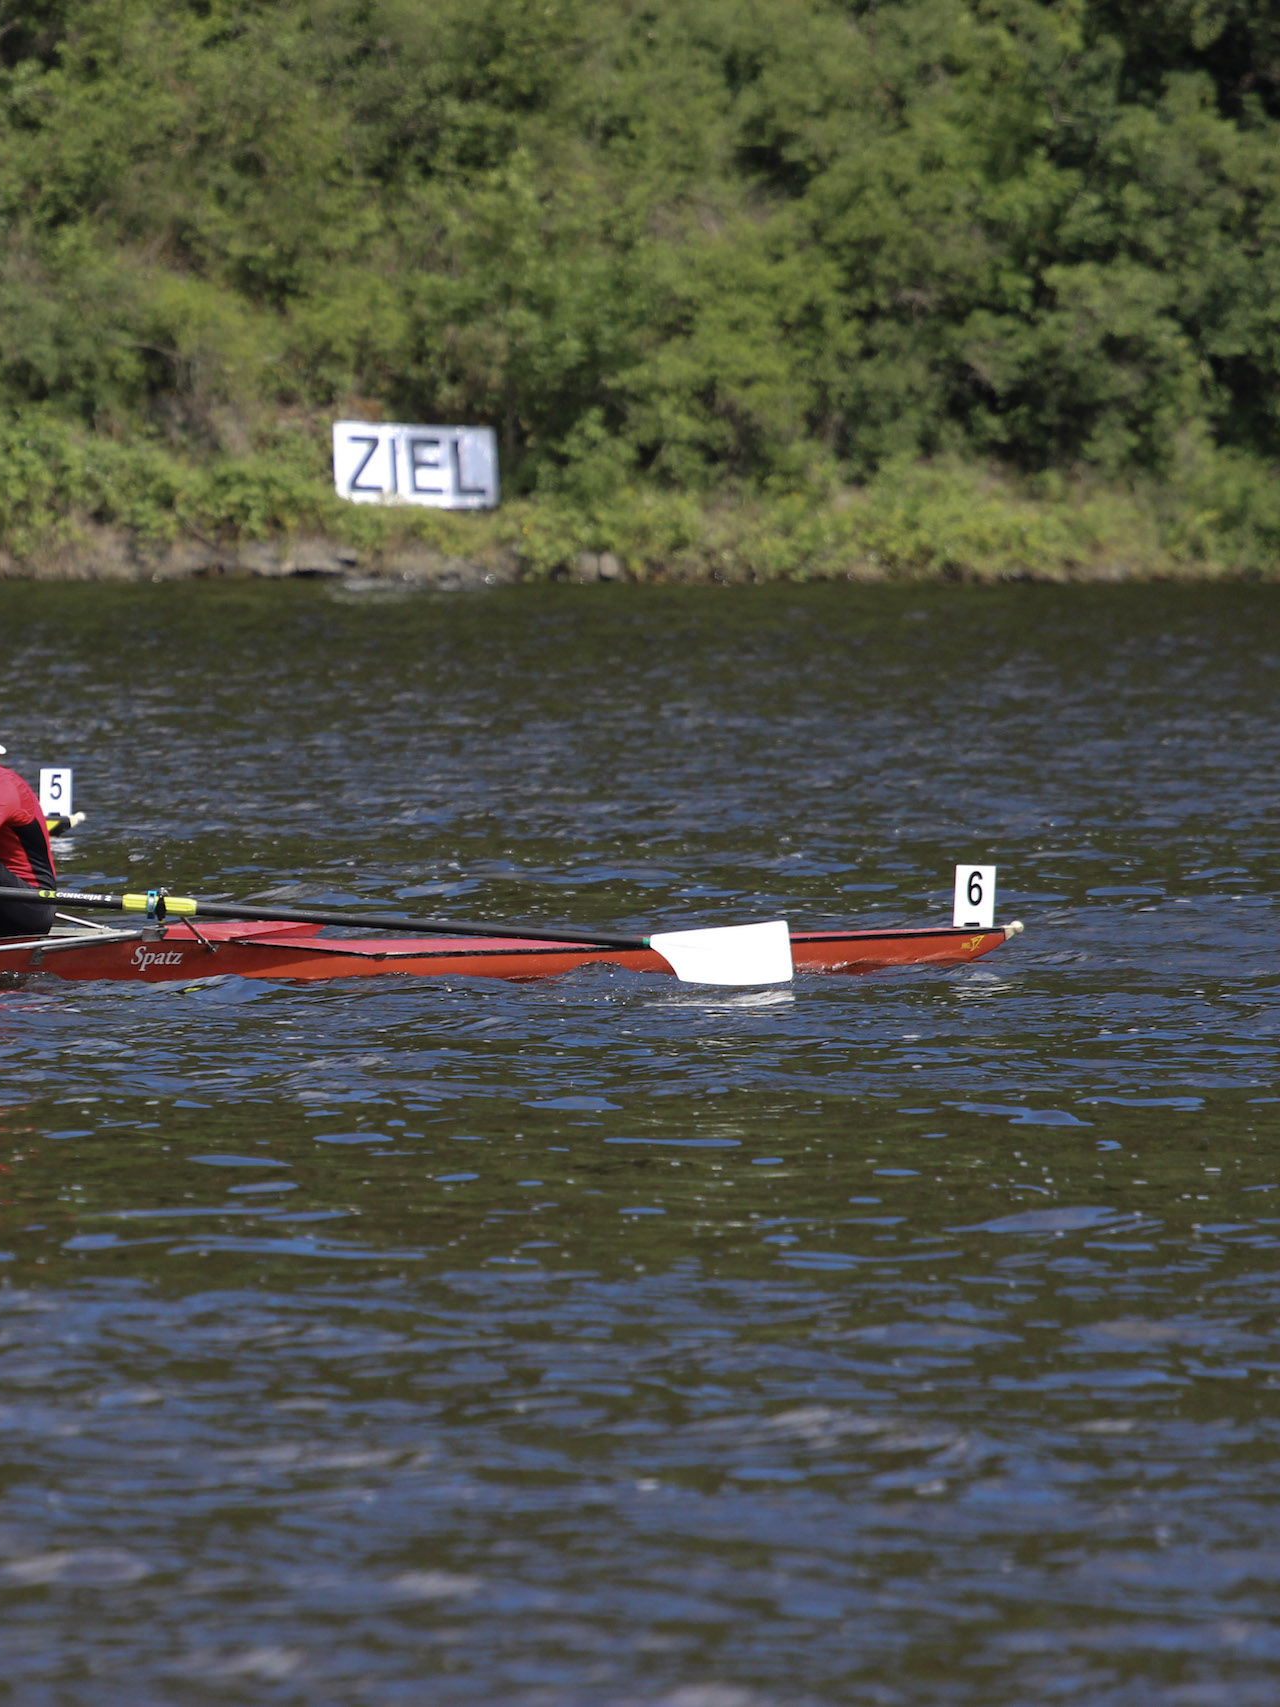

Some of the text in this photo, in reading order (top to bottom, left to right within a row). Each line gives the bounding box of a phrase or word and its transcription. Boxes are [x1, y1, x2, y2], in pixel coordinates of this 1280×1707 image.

[347, 436, 486, 495] ZIEL
[50, 774, 62, 800] 5
[967, 870, 983, 906] 6
[130, 945, 183, 971] Spatz
